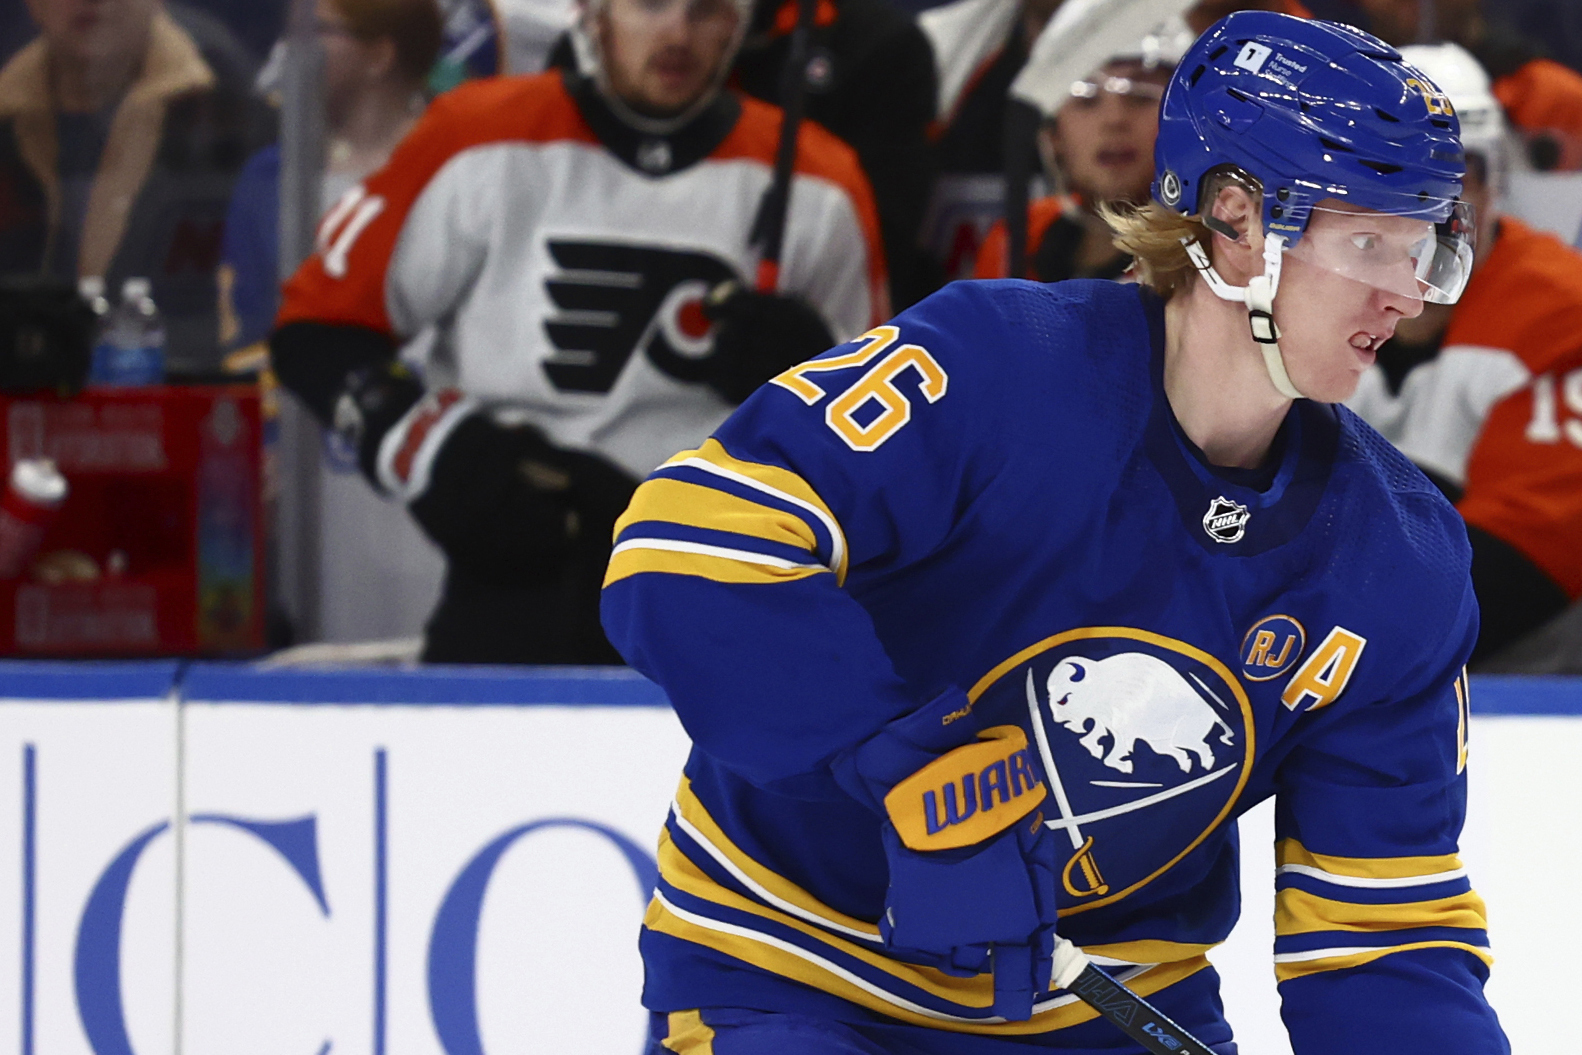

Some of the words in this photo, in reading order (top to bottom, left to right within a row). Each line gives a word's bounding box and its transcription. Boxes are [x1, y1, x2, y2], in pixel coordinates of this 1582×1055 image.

[1268, 61, 1292, 76] Nurse
[1274, 53, 1307, 73] Trusted
[768, 325, 949, 452] 26
[1211, 514, 1239, 529] NHL
[1245, 630, 1296, 668] RJ
[1281, 625, 1367, 711] A
